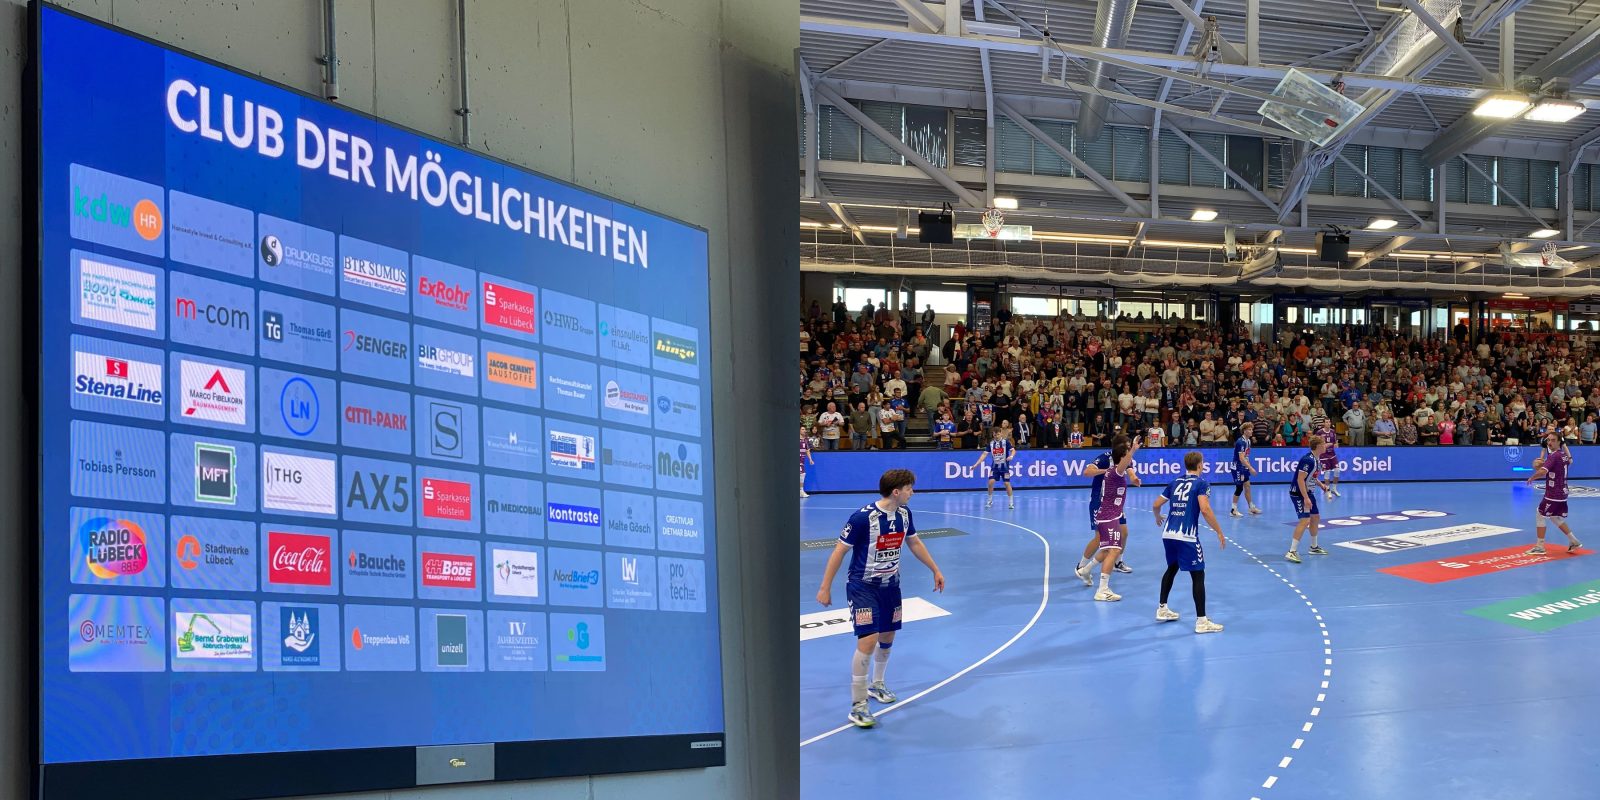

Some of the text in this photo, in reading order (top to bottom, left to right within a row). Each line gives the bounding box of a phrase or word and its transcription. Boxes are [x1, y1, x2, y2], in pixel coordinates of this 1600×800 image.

[166, 78, 649, 269] CLUB DER MÖGLICHKEITEN
[74, 185, 131, 228] kdw
[139, 213, 157, 230] HR
[271, 239, 277, 249] d
[266, 254, 273, 263] s
[285, 246, 334, 268] DRUCKGUSS
[344, 256, 407, 283] BTR SUMUS
[419, 276, 471, 304] ExRohr
[176, 297, 249, 330] m-com
[498, 297, 534, 315] Sparkasse
[290, 322, 315, 335] Thomas
[499, 315, 534, 330] zu Lübeck
[554, 312, 579, 331] HWB
[265, 322, 281, 339] TG
[356, 334, 407, 359] SENGER
[113, 362, 120, 375] S
[489, 359, 532, 374] JACOB CEMENT
[488, 367, 533, 383] BAUSTOFFE
[75, 374, 162, 403] Stena Line
[189, 389, 211, 401] MARCO
[192, 401, 238, 413] BAUMANAGEMENT
[290, 399, 310, 420] LN
[345, 406, 407, 430] CITTI-PARK
[435, 411, 459, 450] S
[79, 459, 156, 479] Tobias Persson
[945, 462, 974, 478] Du
[980, 460, 1023, 478] hst
[1028, 460, 1057, 477] die
[1352, 455, 1392, 474] Spiel
[202, 467, 228, 483] MFT
[274, 468, 302, 484] THG
[347, 471, 409, 513] AX5
[437, 491, 470, 503] Sparkasse
[1173, 482, 1193, 501] 42
[437, 505, 465, 516] Holstein
[501, 503, 542, 516] MEDICOBAU
[549, 506, 599, 524] kontraste
[608, 520, 651, 533] Malte Gösch
[665, 515, 694, 526] CREATIVLAB
[889, 521, 896, 532] 4
[88, 529, 129, 547] RADIO
[683, 528, 698, 538] BAUM
[88, 544, 143, 564] LÜBECK
[205, 543, 249, 556] Stadtwerke
[205, 556, 234, 566] Lübeck
[358, 553, 405, 571] Bauche
[442, 560, 472, 576] BODE
[669, 563, 684, 581] pro
[669, 584, 689, 600] tech
[95, 624, 151, 639] MEMTEX
[508, 621, 526, 635] IV
[195, 634, 249, 643] Bernd Grabowski
[363, 634, 410, 646] Treppenbau Voß
[441, 643, 463, 653] unizell
